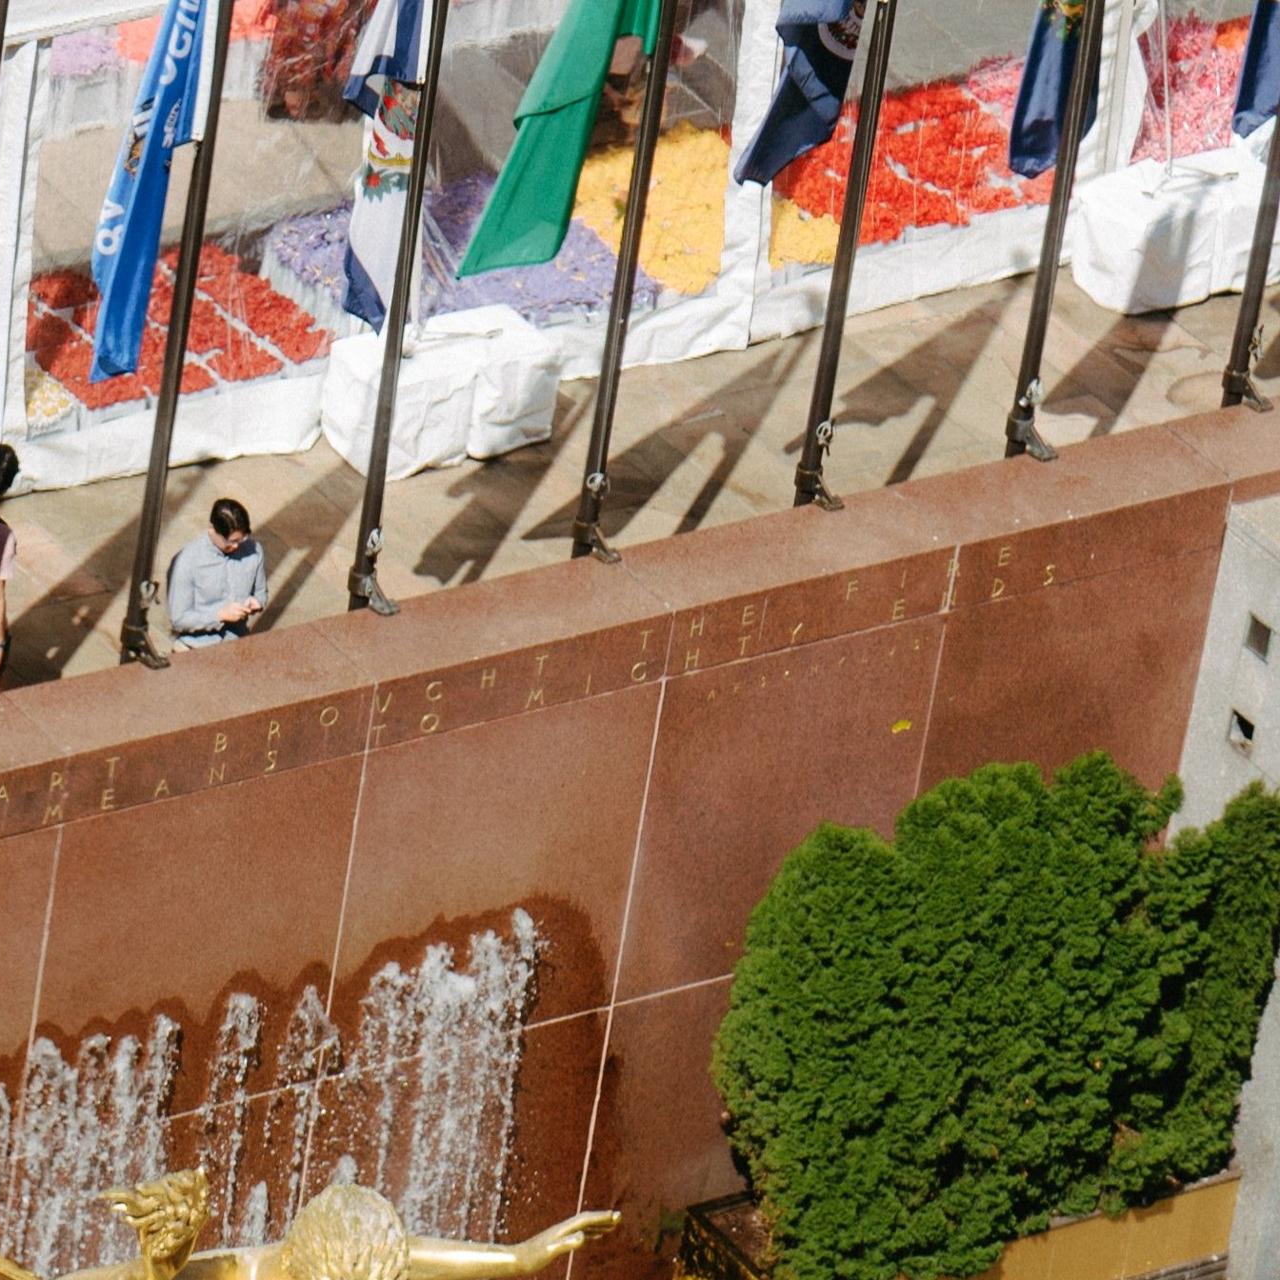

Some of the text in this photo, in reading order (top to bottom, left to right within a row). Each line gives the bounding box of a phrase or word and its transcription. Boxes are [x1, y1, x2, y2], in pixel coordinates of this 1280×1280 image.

[638, 604, 756, 652] THE
[845, 547, 1012, 600] FIRE
[43, 751, 278, 824] MEANS
[370, 712, 441, 746] TO
